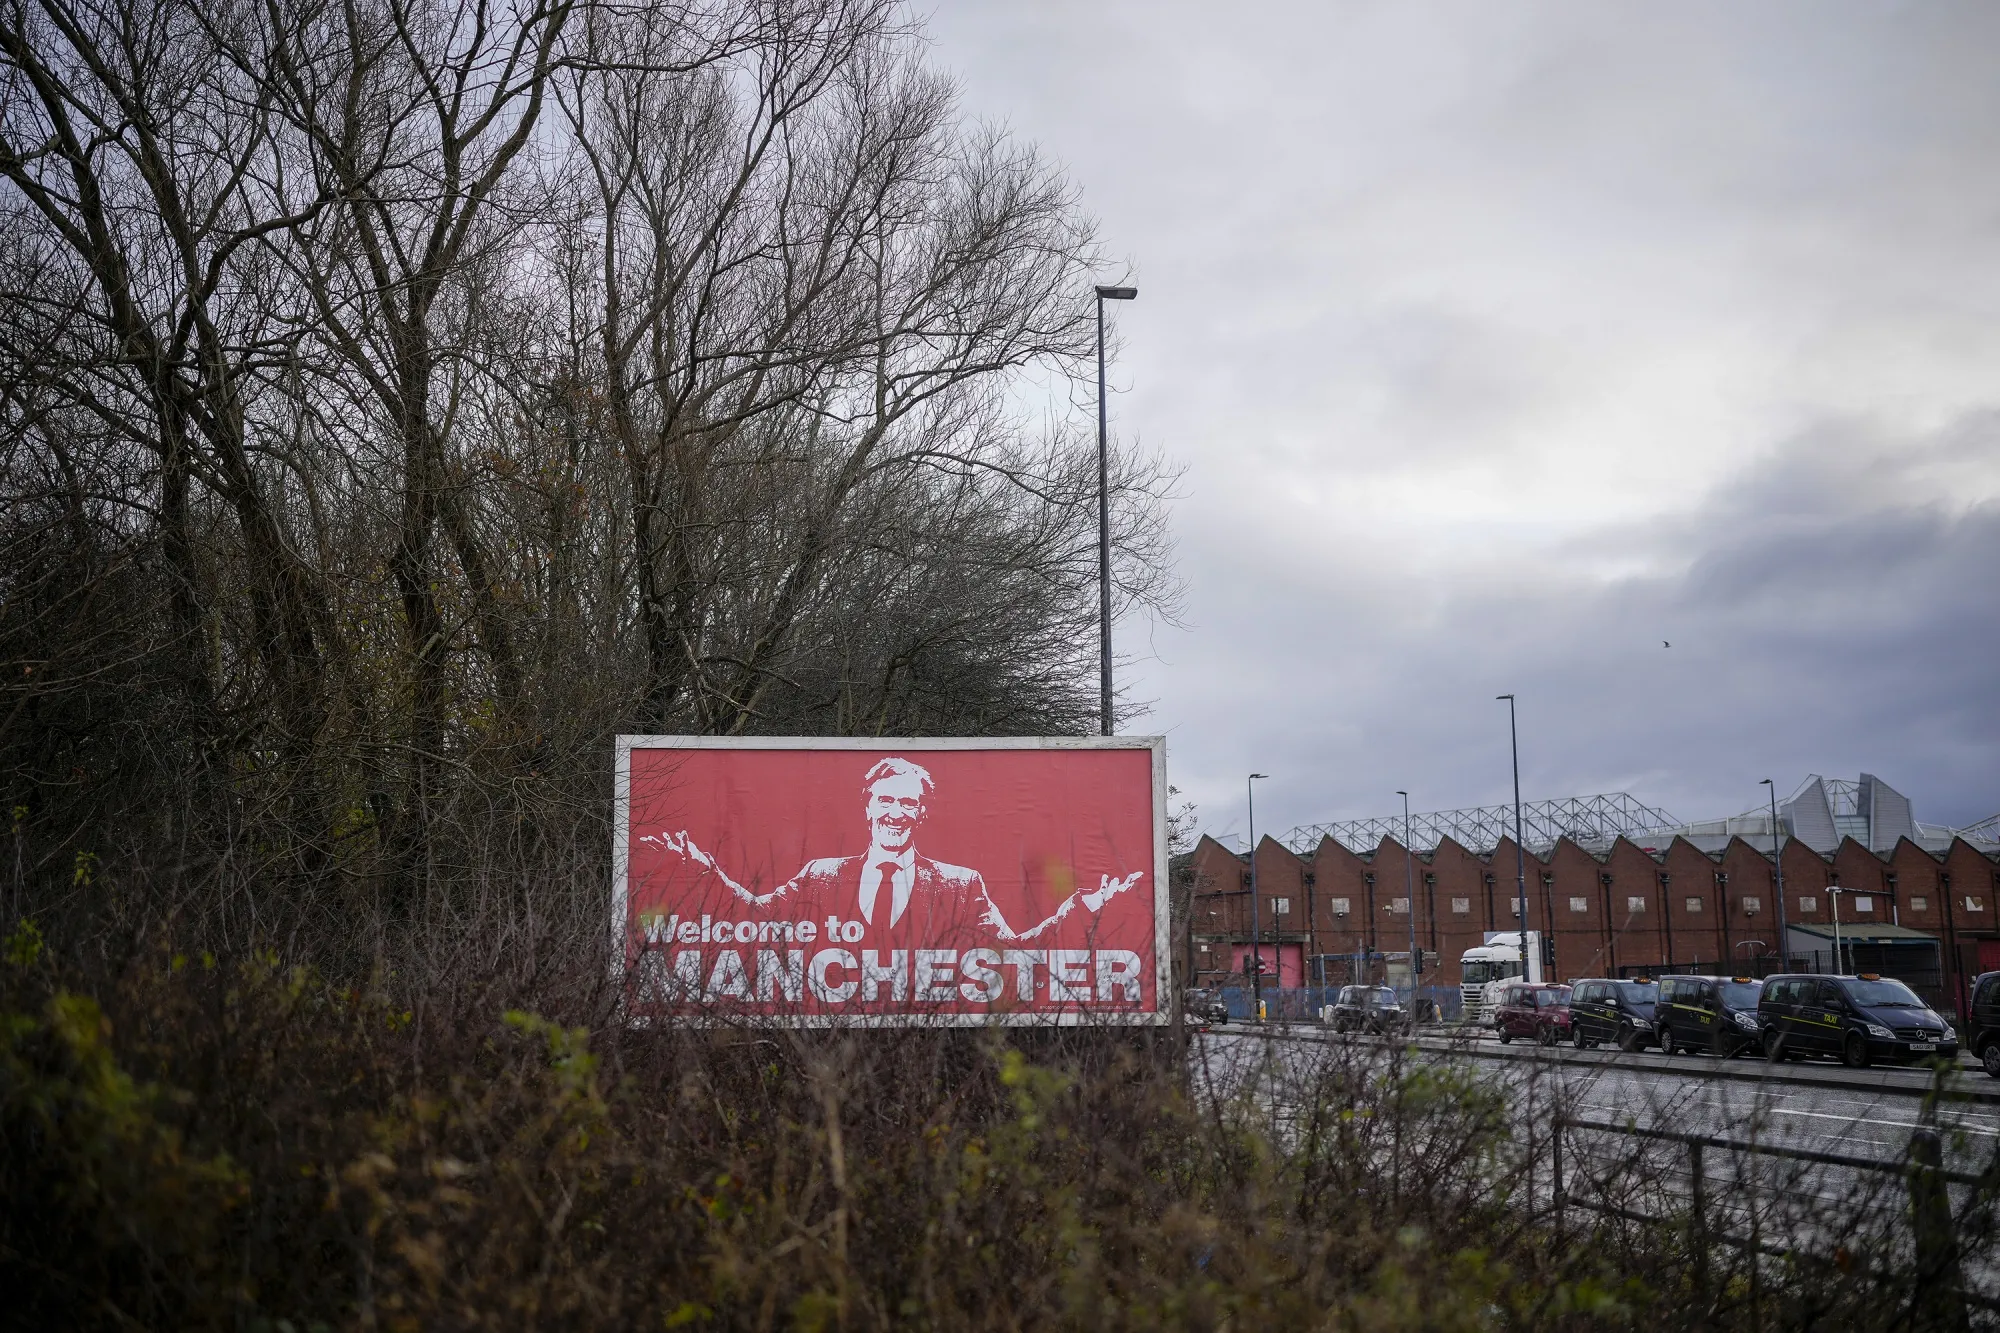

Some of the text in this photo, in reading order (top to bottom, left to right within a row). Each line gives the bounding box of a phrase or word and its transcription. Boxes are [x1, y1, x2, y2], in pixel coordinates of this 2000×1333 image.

[641, 914, 864, 943] Welcome to
[638, 948, 1142, 1003] MANCHESTER
[1823, 1013, 1838, 1024] TAXI
